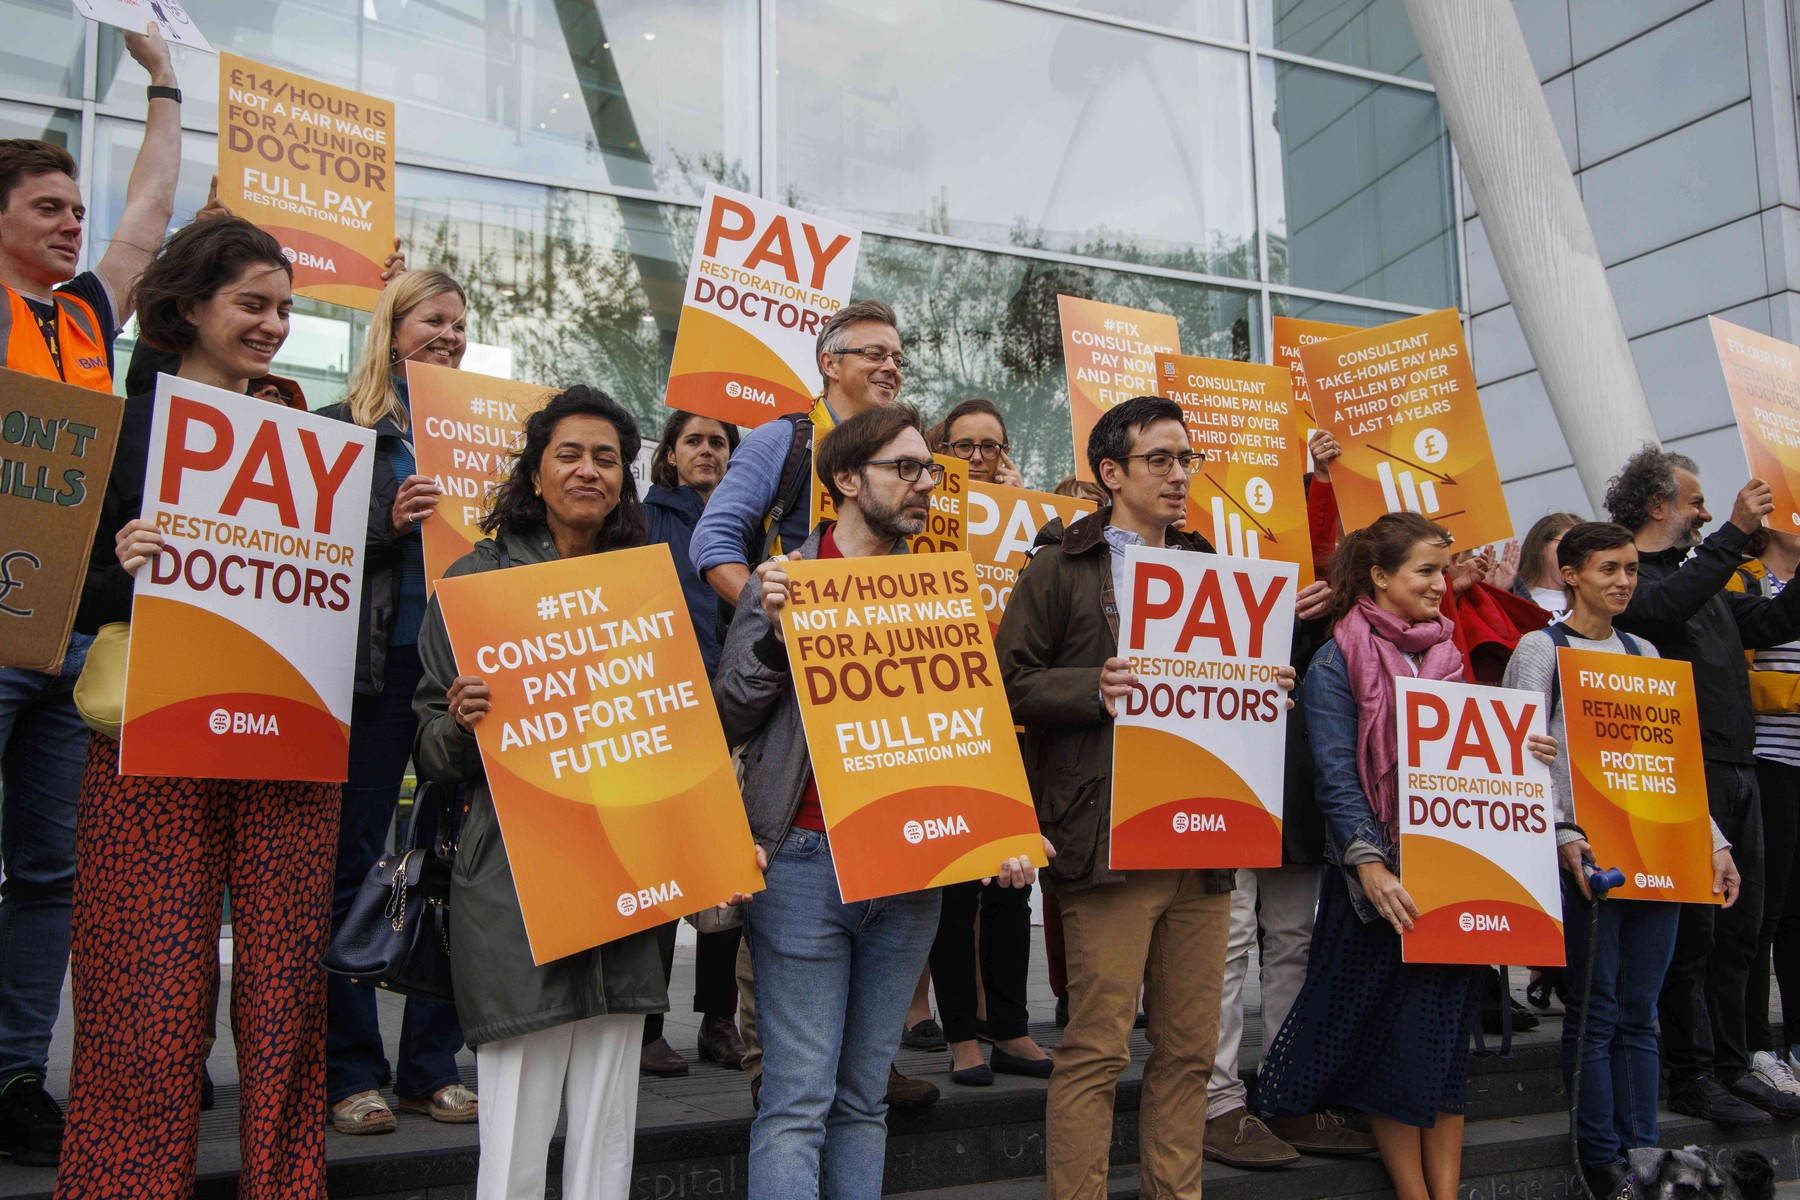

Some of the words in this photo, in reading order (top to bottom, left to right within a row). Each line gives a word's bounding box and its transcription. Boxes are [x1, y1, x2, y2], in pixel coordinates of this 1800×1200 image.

[230, 68, 359, 121] £14/HOUR
[366, 108, 386, 127] IS
[229, 87, 269, 110] NOT
[273, 102, 286, 117] A
[291, 106, 331, 129] FAIR
[335, 119, 386, 145] WAGE
[229, 104, 277, 133] FOR
[282, 122, 299, 139] A
[303, 127, 386, 163] JUNIOR
[228, 124, 386, 192] DOCTOR
[243, 168, 317, 207] FULL
[324, 188, 373, 220] PAY
[243, 190, 339, 224] RESTORATION
[341, 213, 372, 232] NOW
[703, 195, 852, 291] PAY
[298, 252, 337, 274] BMA
[699, 260, 807, 303] RESTORATION
[810, 293, 841, 312] FOR
[1104, 319, 1139, 337] #FIX
[1091, 351, 1119, 368] PAY
[1337, 333, 1429, 367] CONSULTANT
[1077, 367, 1111, 384] AND
[1114, 373, 1145, 391] FOR
[1187, 374, 1265, 395] CONSULTANT
[1316, 358, 1400, 391] TAKE-HOME
[1402, 352, 1426, 370] PAY
[1428, 344, 1458, 362] HAS
[1335, 382, 1388, 404] FALLEN
[1390, 375, 1407, 390] BY
[1410, 364, 1448, 385] OVER
[470, 397, 519, 424] #FIX
[742, 386, 776, 408] BMA
[1167, 390, 1239, 410] TAKE-HOME
[1242, 397, 1264, 413] PAY
[1265, 400, 1288, 415] HAS
[1333, 410, 1344, 423] A
[1345, 398, 1388, 420] THIRD
[1391, 387, 1430, 407] OVER
[1430, 379, 1459, 397] THE
[0, 411, 97, 458] ON'T
[1183, 410, 1229, 427] FALLEN
[1231, 414, 1245, 428] BY
[1247, 416, 1279, 431] OVER
[1349, 416, 1383, 437] LAST
[1387, 412, 1403, 426] 14
[1404, 399, 1451, 421] YEARS
[1759, 424, 1785, 445] THE
[1189, 429, 1227, 444] THIRD
[1230, 432, 1262, 447] OVER
[1263, 435, 1287, 449] THE
[159, 395, 364, 535] PAY
[453, 449, 490, 473] PAY
[1225, 451, 1239, 463] 14
[1240, 452, 1279, 466] YEARS
[0, 457, 86, 507] ILLS
[433, 474, 478, 499] AND
[943, 472, 960, 494] IS
[930, 494, 960, 515] AGE
[156, 511, 310, 559] RESTORATION
[315, 541, 354, 567] FOR
[150, 544, 351, 612] DOCTORS
[790, 571, 937, 606] £14/HOUR
[943, 569, 969, 595] IS
[536, 587, 609, 621] #FIX
[792, 608, 839, 631] NOT
[845, 606, 861, 627] A
[865, 603, 911, 626] FAIR
[914, 598, 975, 621] WAGE
[1129, 561, 1288, 659] PAY
[476, 610, 676, 675] CONSULTANT
[798, 632, 855, 661] FOR
[863, 632, 882, 656] A
[887, 622, 983, 658] JUNIOR
[521, 661, 577, 705] PAY
[585, 651, 655, 692] NOW
[804, 651, 994, 706] DOCTOR
[1127, 656, 1245, 683] RESTORATION
[1250, 664, 1280, 683] FOR
[1579, 670, 1606, 690] FIX
[1608, 673, 1646, 695] OUR
[1649, 678, 1677, 697] PAY
[499, 708, 569, 753] AND
[572, 695, 637, 735] FOR
[638, 680, 699, 715] THE
[1126, 682, 1279, 723] DOCTORS
[1582, 699, 1643, 722] RETAIN
[1645, 706, 1682, 726] OUR
[232, 713, 280, 737] BMA
[835, 715, 924, 754] FULL
[928, 707, 985, 741] PAY
[1406, 690, 1537, 777] PAY
[1595, 721, 1675, 745] DOCTORS
[549, 724, 673, 779] FUTURE
[843, 746, 954, 773] RESTORATION
[956, 738, 992, 758] NOW
[1600, 750, 1675, 774] PROTECT
[1408, 772, 1512, 796] RESTORATION
[1515, 781, 1544, 799] FOR
[1603, 771, 1638, 792] THE
[1641, 775, 1677, 795] NHS
[924, 815, 970, 840] BMA
[1190, 813, 1226, 832] BMA
[1408, 795, 1547, 834] DOCTORS
[637, 879, 684, 909] BMA
[1647, 874, 1675, 889] BMA
[1476, 914, 1510, 932] BMA
